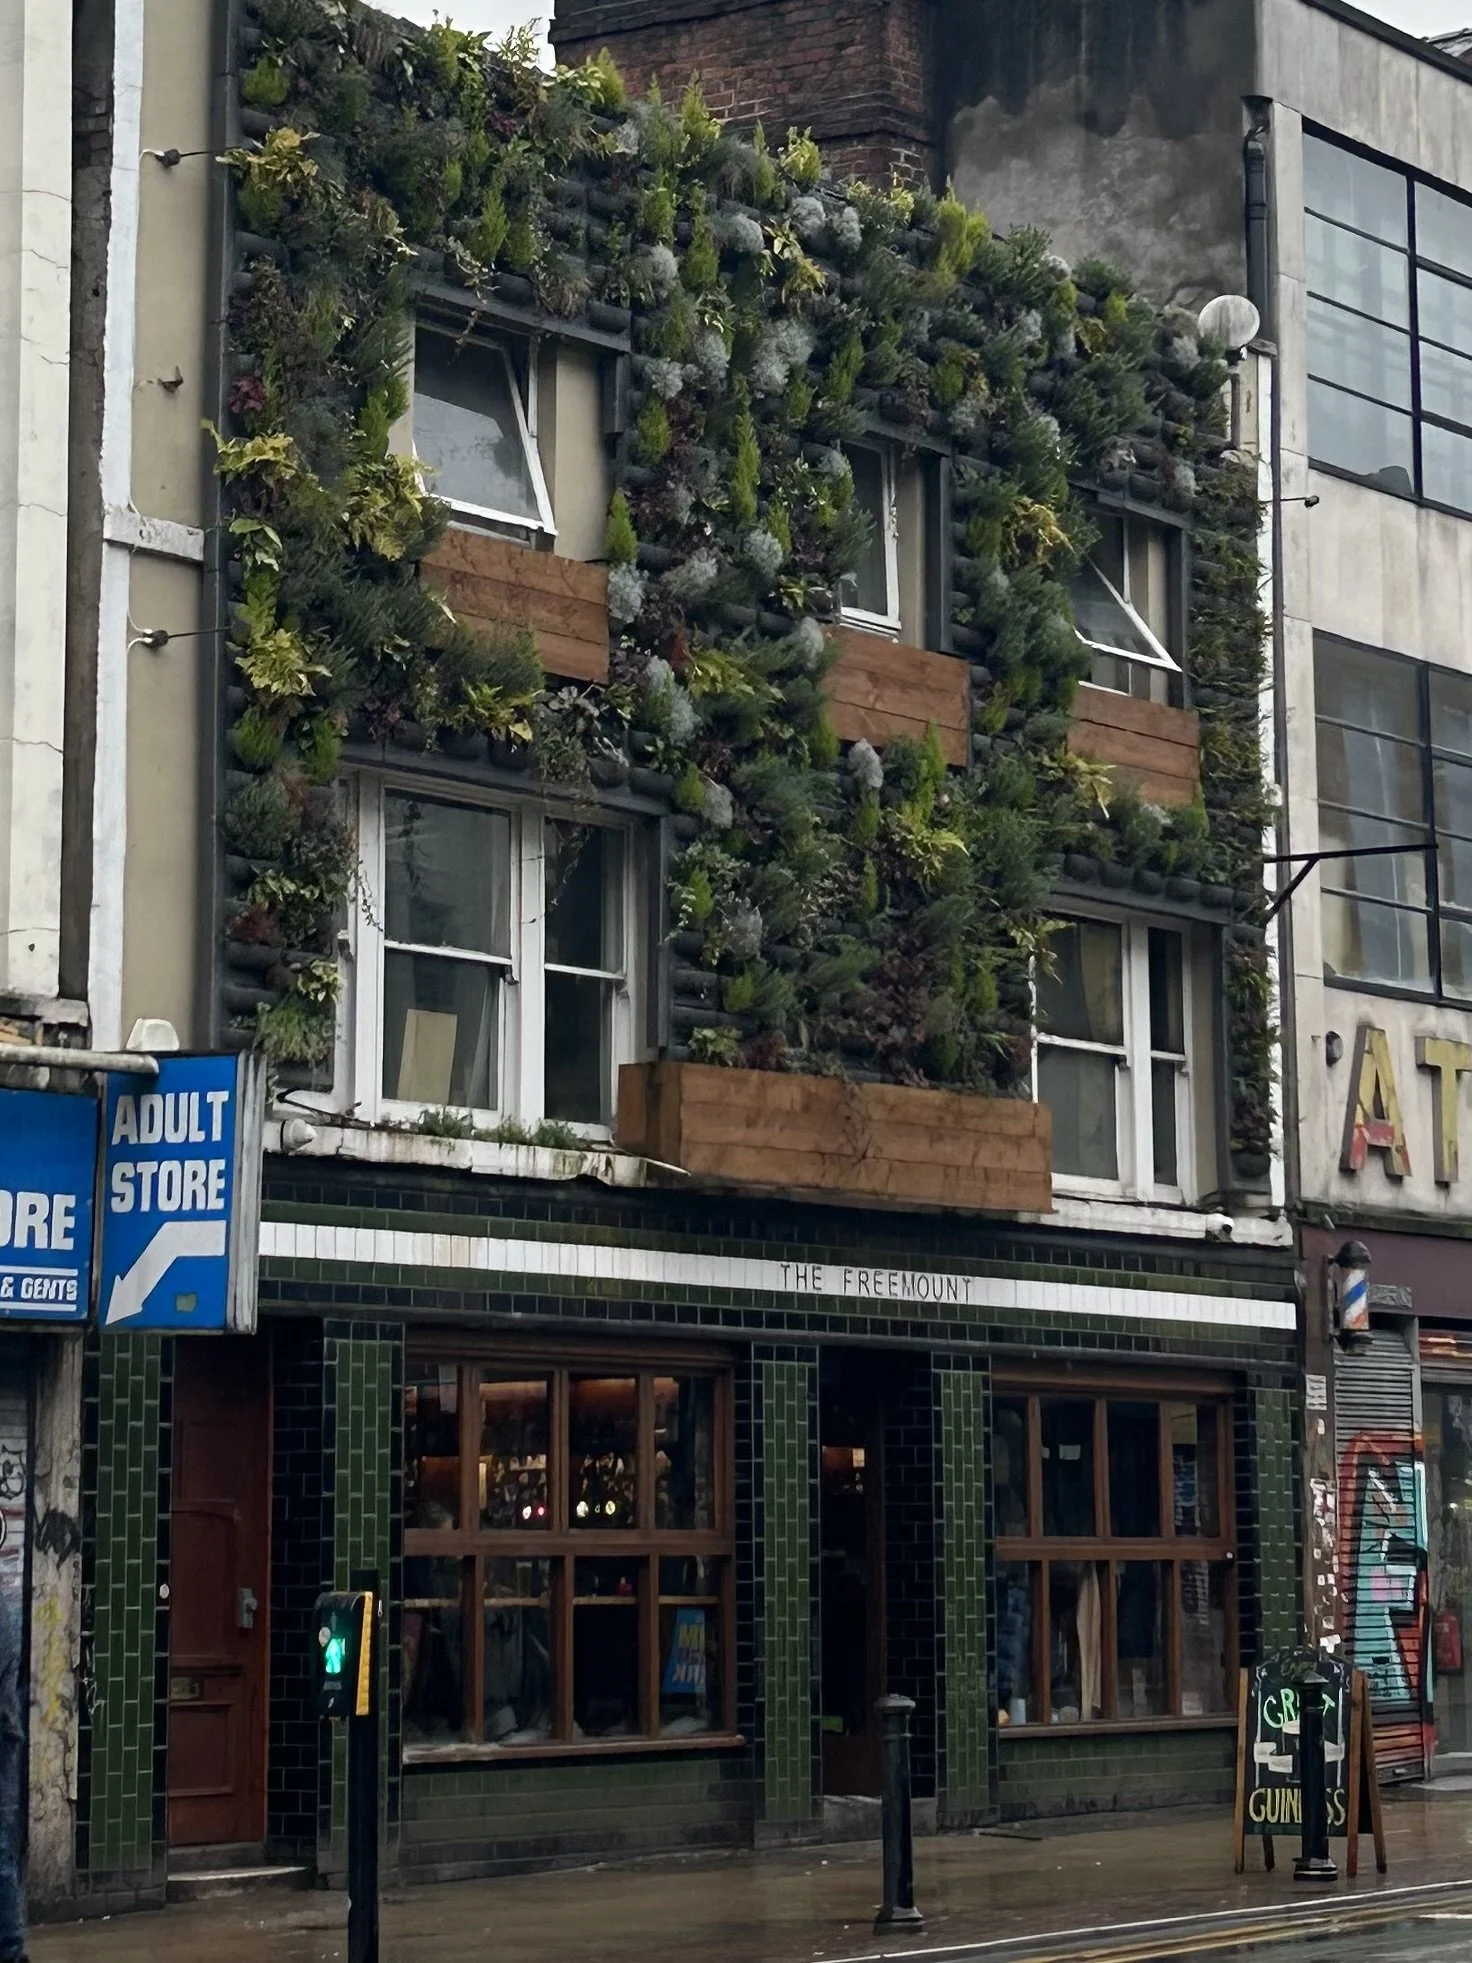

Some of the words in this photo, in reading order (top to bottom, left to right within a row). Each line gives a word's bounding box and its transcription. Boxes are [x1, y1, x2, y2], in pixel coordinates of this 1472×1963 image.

[111, 1091, 229, 1145] ADULT
[110, 1159, 226, 1213] STORE
[21, 1277, 77, 1301] GENTS
[780, 1263, 822, 1291] THE
[843, 1267, 972, 1304] FREEMOUNT
